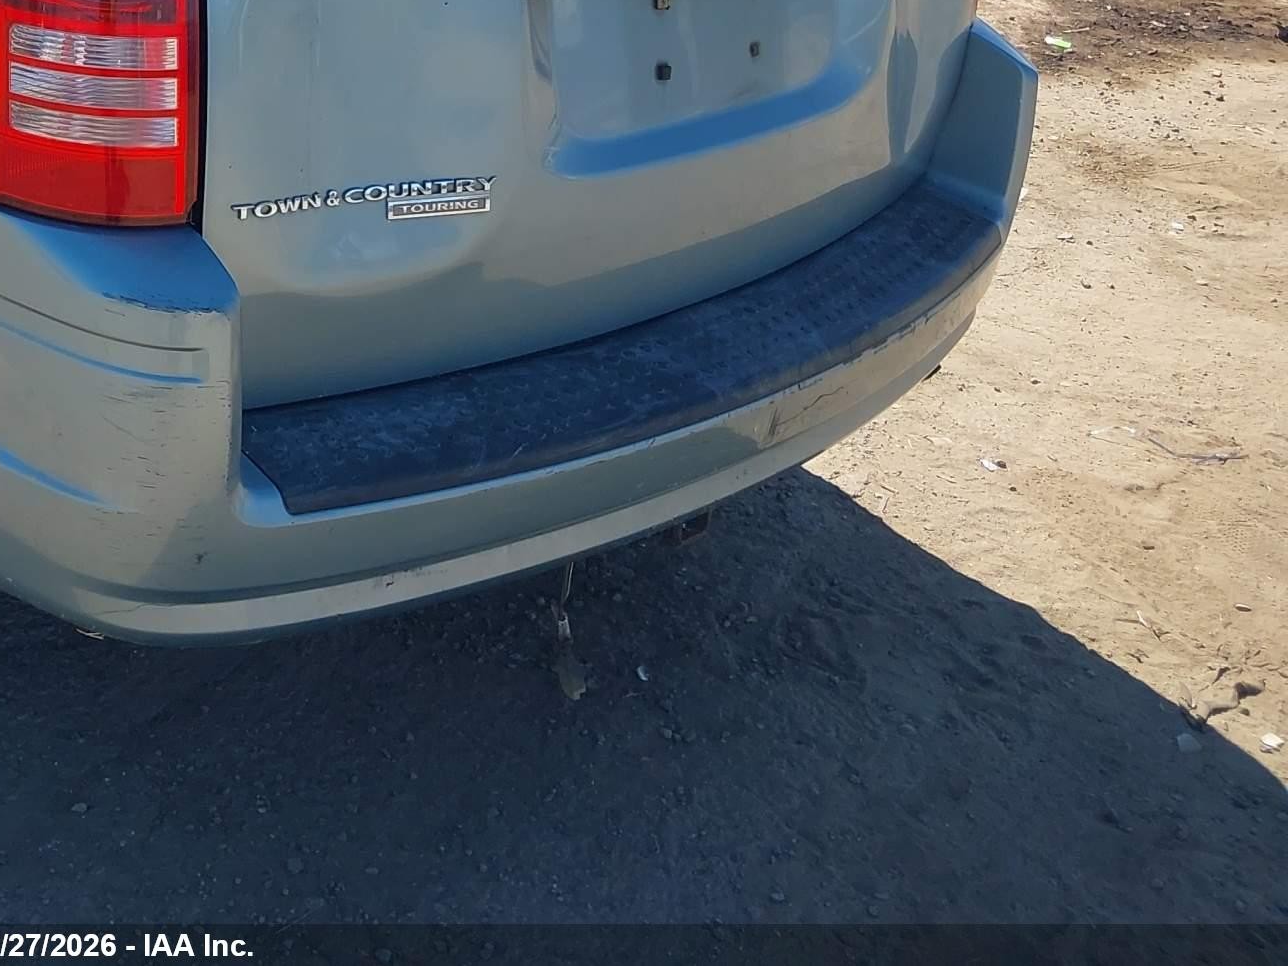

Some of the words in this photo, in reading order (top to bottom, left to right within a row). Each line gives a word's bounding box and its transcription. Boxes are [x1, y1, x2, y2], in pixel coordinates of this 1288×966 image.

[231, 193, 322, 220] TOWN
[325, 189, 340, 207] &
[343, 175, 496, 204] COUNTRY
[400, 199, 480, 214] TOURING
